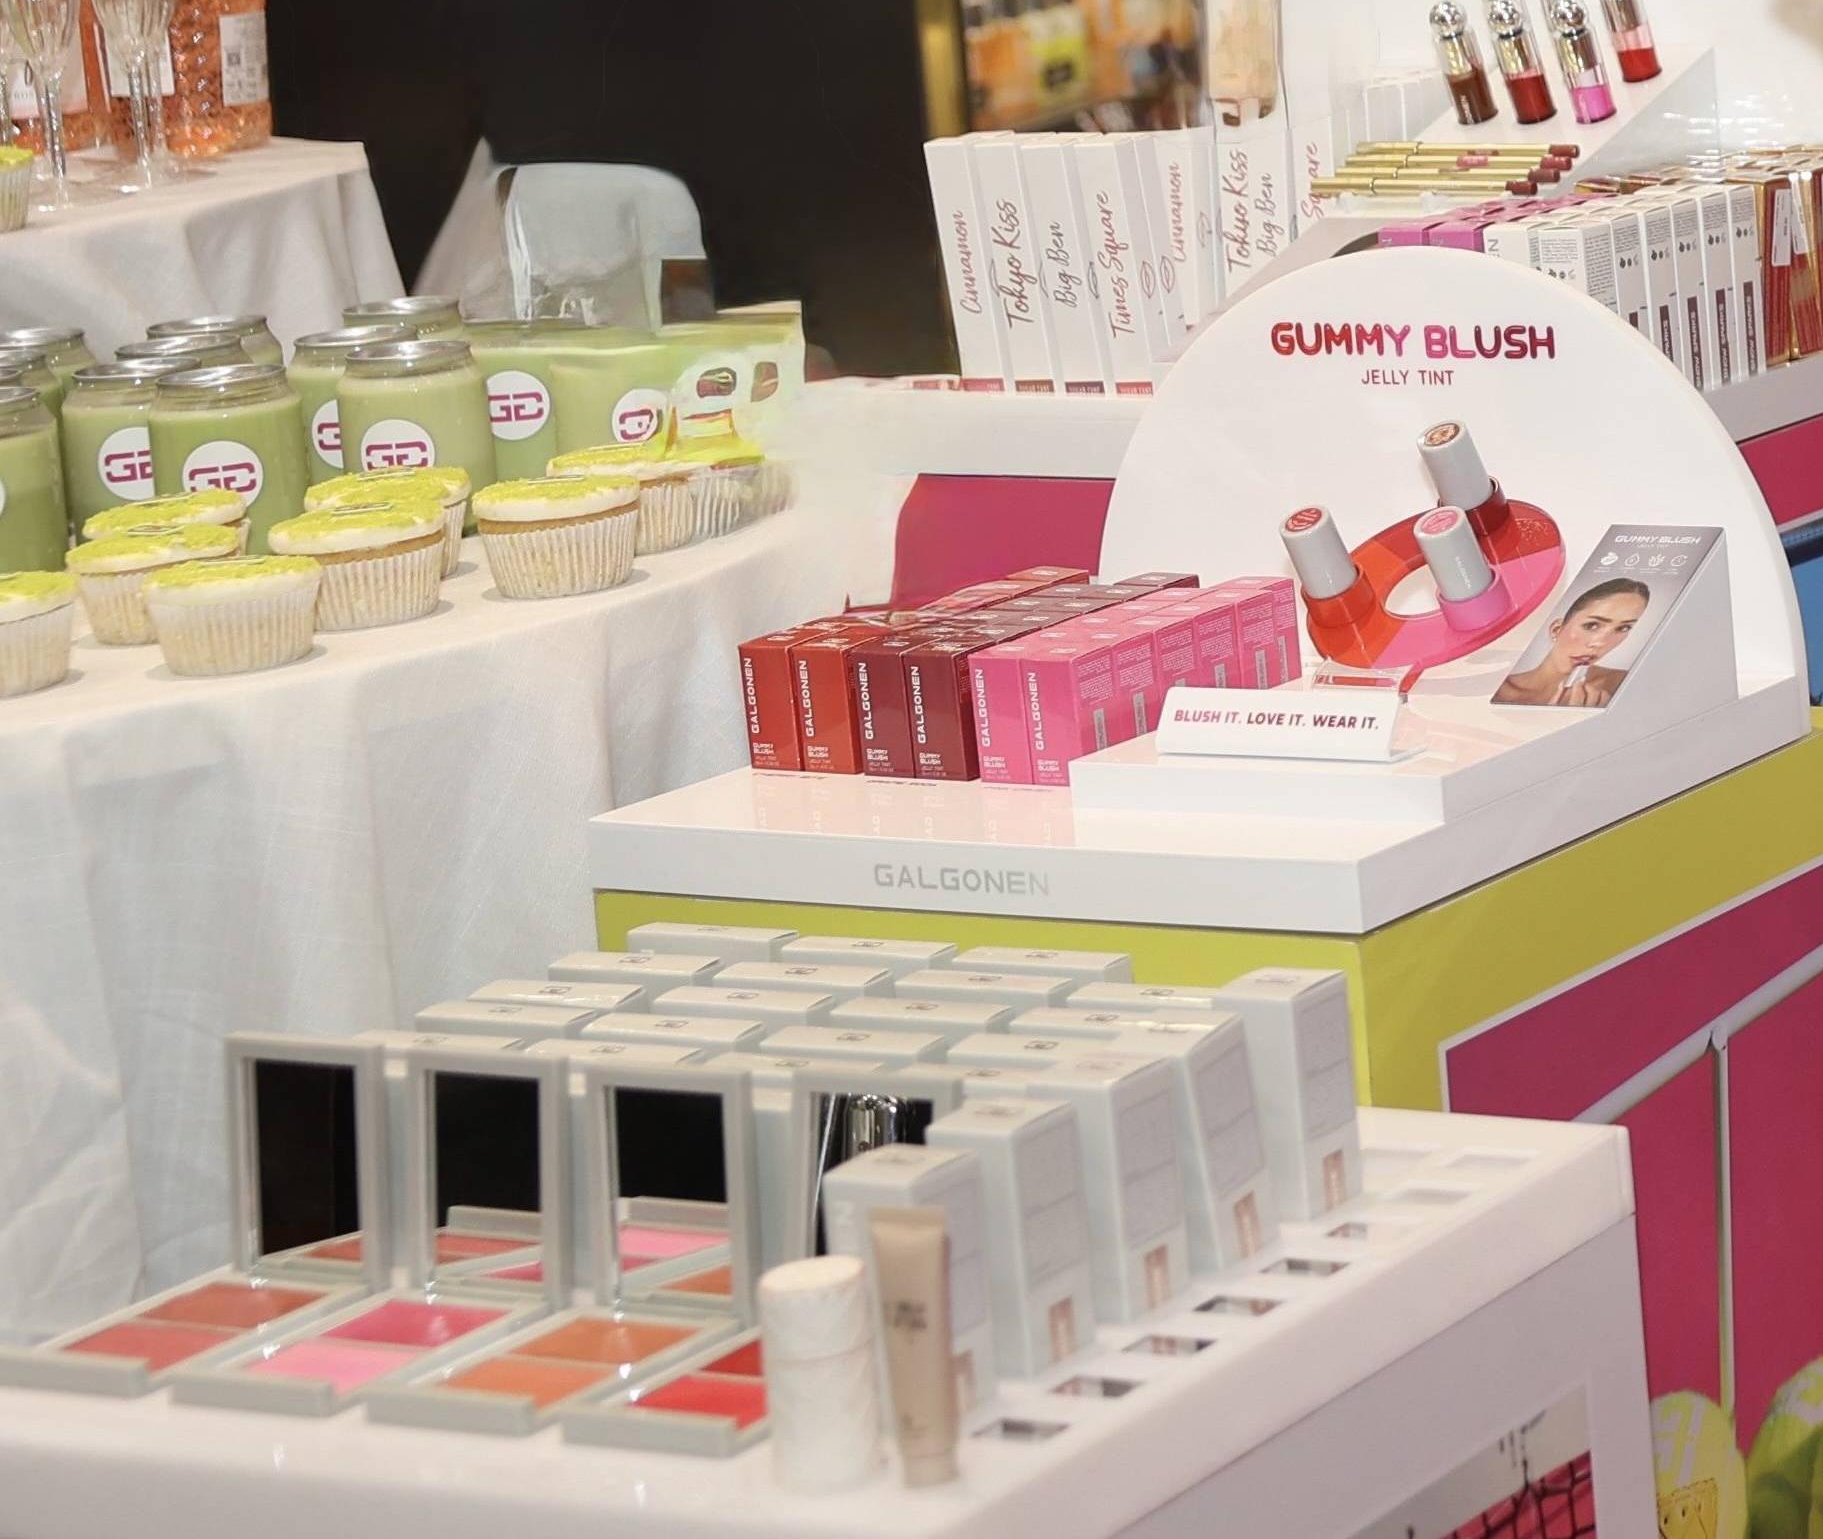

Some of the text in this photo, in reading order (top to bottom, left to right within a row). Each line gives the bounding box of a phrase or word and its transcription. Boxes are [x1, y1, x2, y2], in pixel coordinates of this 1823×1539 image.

[1221, 148, 1249, 198] Kiss
[1300, 141, 1325, 220] Sqare
[1253, 172, 1285, 257] Big Ben
[957, 210, 982, 315] Cinnamon
[990, 198, 1037, 329] Tokyo Kiss
[1045, 220, 1083, 308] Big Ben
[1096, 190, 1135, 339] Times Square
[1271, 322, 1556, 359] GUMMY BLUSH
[1361, 369, 1455, 385] JELLY TINT
[743, 657, 760, 734] GALGONEN
[799, 660, 815, 737] GALGONEN
[858, 662, 875, 740] GALGONEN
[910, 666, 927, 744] GALGONEN
[975, 668, 991, 748] GALGONEN
[1027, 672, 1045, 751] GALGONEN
[1173, 709, 1379, 730] BLUSH IT. LOVE IT. WEAR IT.
[874, 863, 1049, 897] GALGONEN
